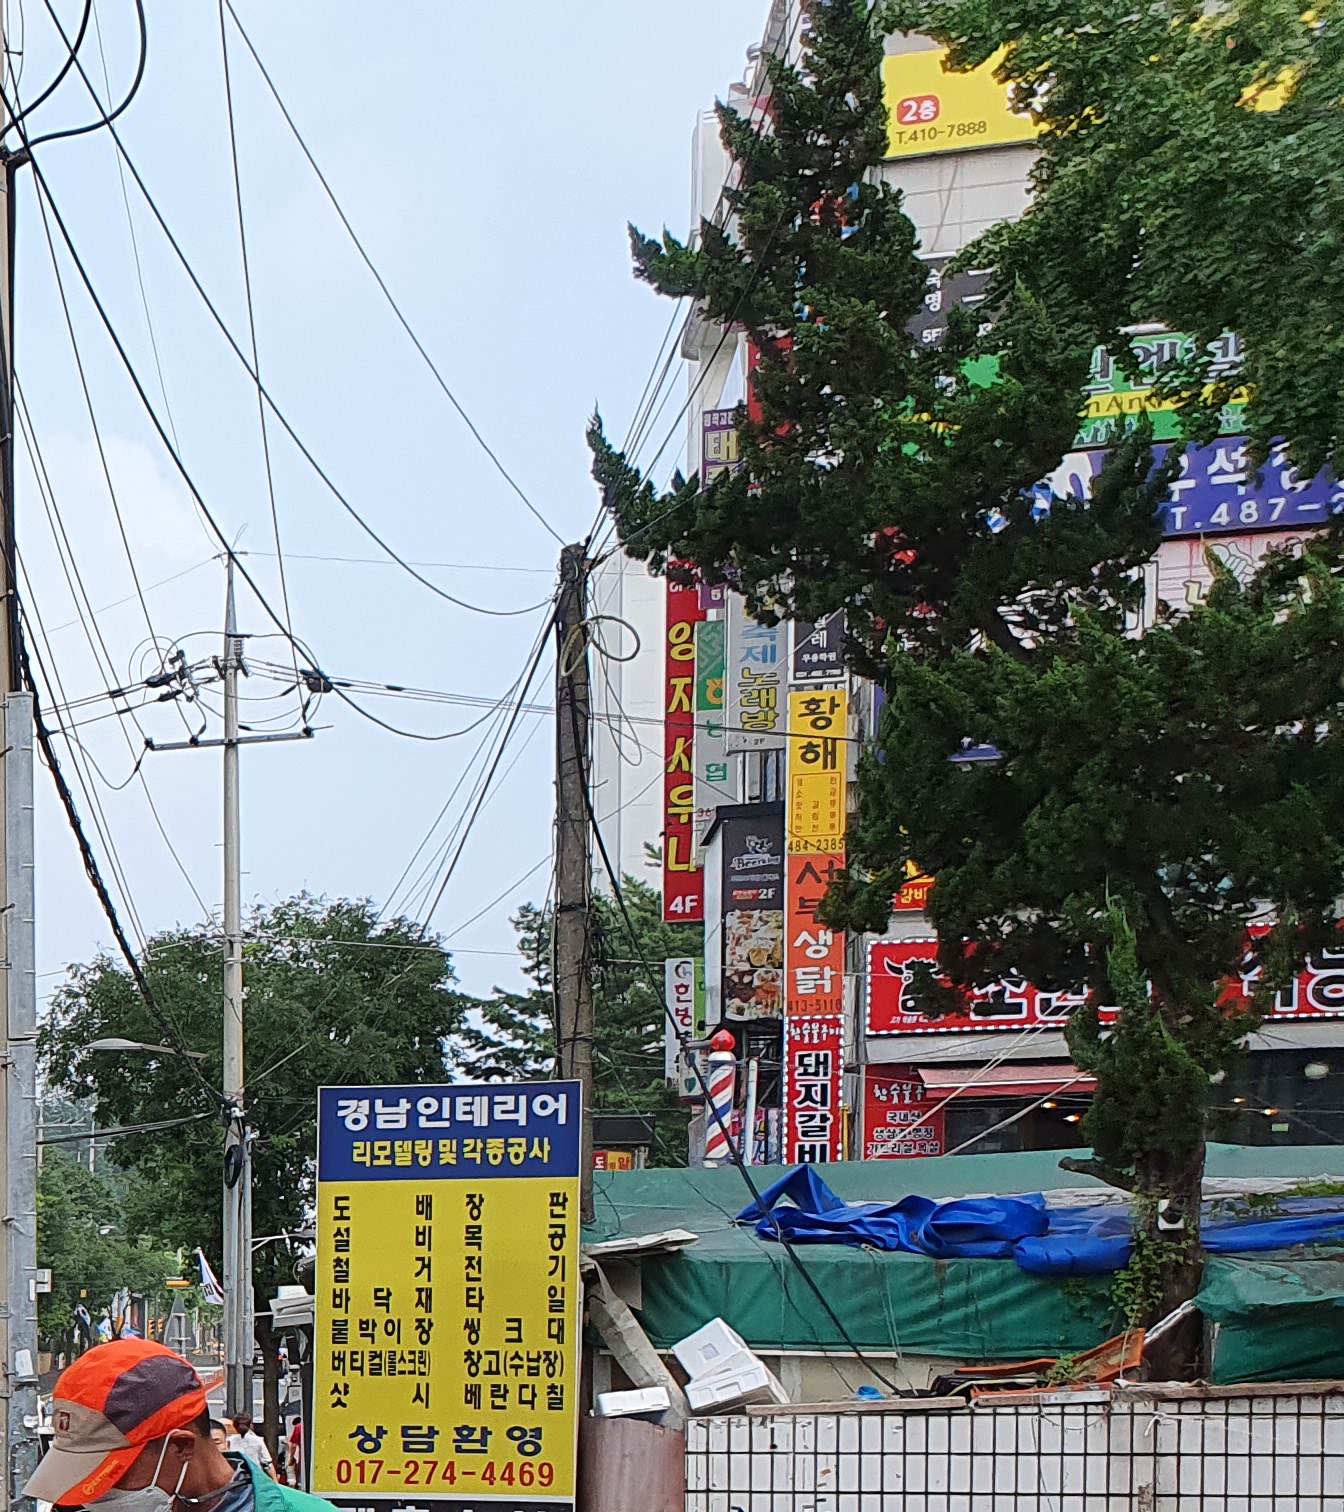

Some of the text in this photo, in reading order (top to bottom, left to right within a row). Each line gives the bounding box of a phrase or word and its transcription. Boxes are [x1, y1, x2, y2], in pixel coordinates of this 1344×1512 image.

[902, 99, 937, 122] 2층
[896, 120, 988, 145] T.410-7888
[737, 666, 781, 732] 노래방
[797, 696, 841, 771] 황해
[669, 895, 699, 914] 4F
[758, 887, 776, 900] 2F
[793, 929, 838, 995] 생닭
[337, 1093, 568, 1131] 경남인테리어
[794, 1050, 834, 1164] 돼지갈비
[352, 1137, 551, 1168] 리모델링 및 각종공사
[331, 1318, 433, 1345] 붙박이장
[331, 1350, 432, 1378] 버티컬(롤스크린)
[464, 1349, 565, 1377] 창고(수납장)
[464, 1382, 565, 1410] 베란다칠
[348, 1424, 544, 1456] 상담환영
[336, 1459, 555, 1487] 017-274-4469
